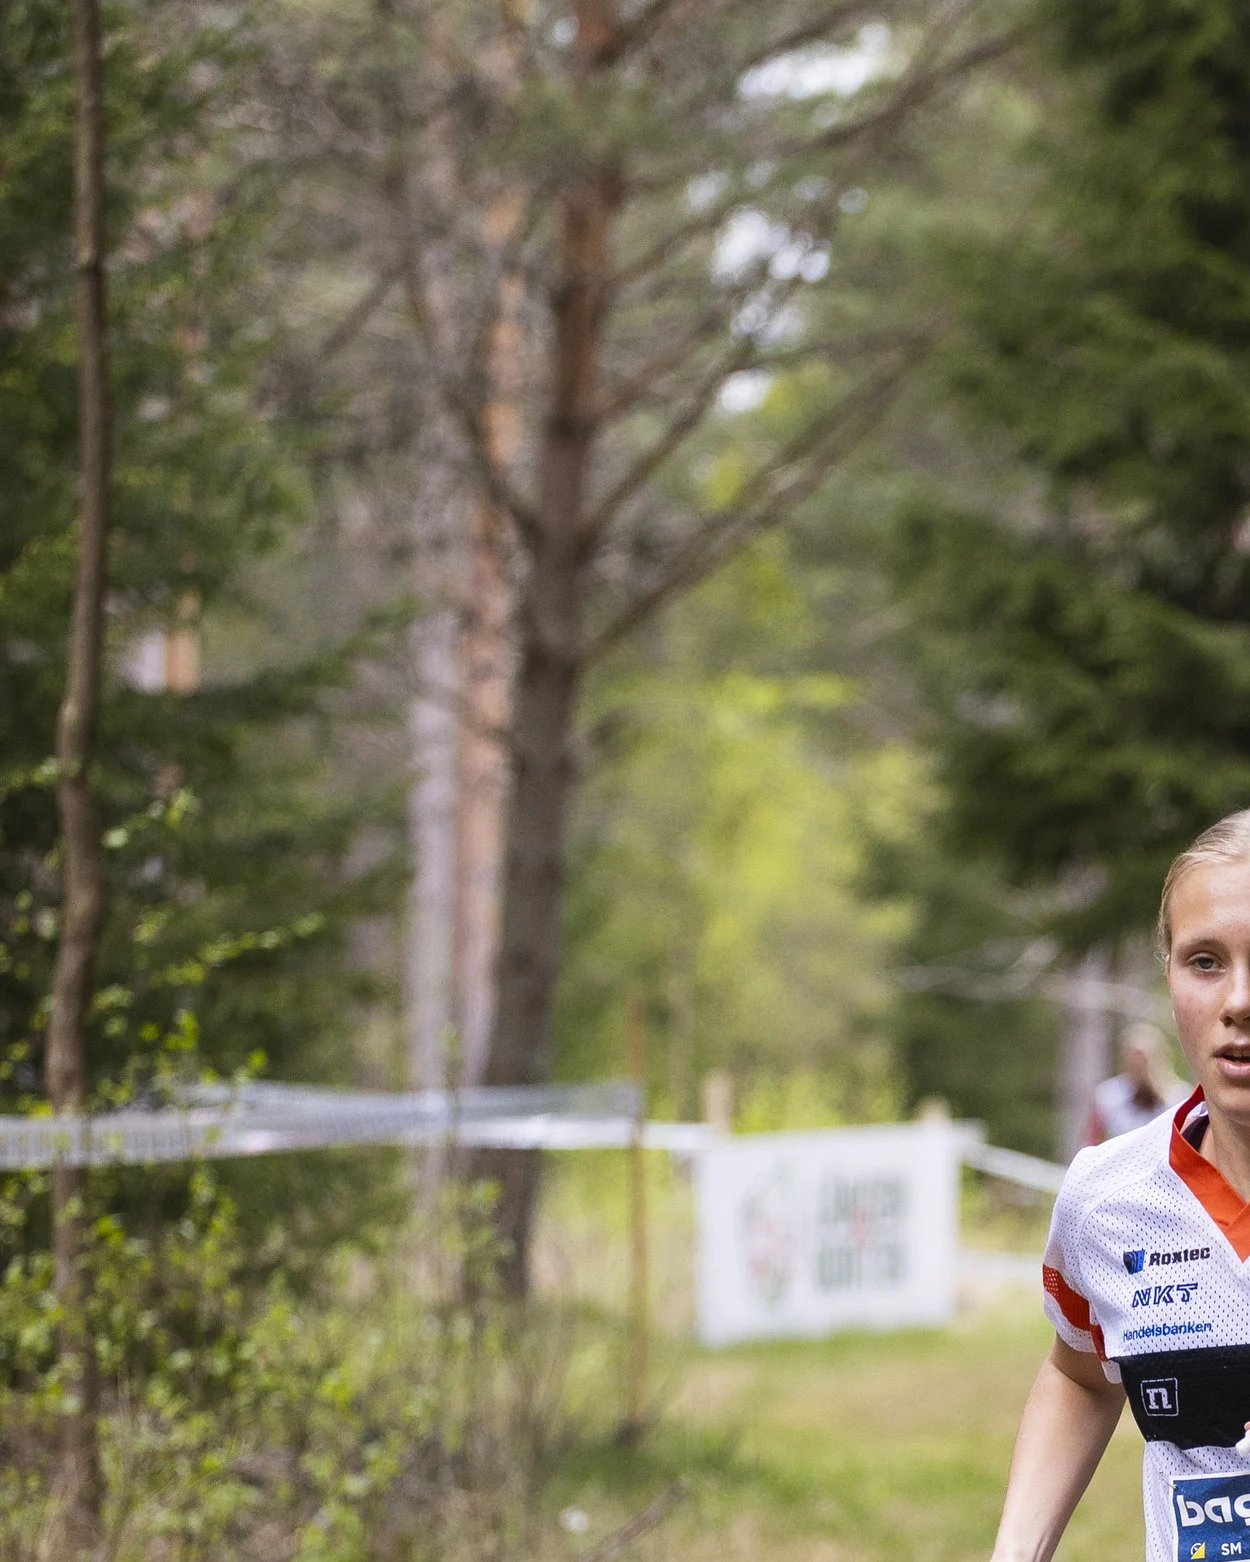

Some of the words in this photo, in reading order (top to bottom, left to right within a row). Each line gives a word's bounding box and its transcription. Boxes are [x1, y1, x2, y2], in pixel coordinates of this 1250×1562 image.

[1149, 1247, 1211, 1267] Roxtec
[1131, 1282, 1199, 1309] NKT
[1123, 1320, 1213, 1342] Handelsbanken
[1221, 1541, 1242, 1556] SM
